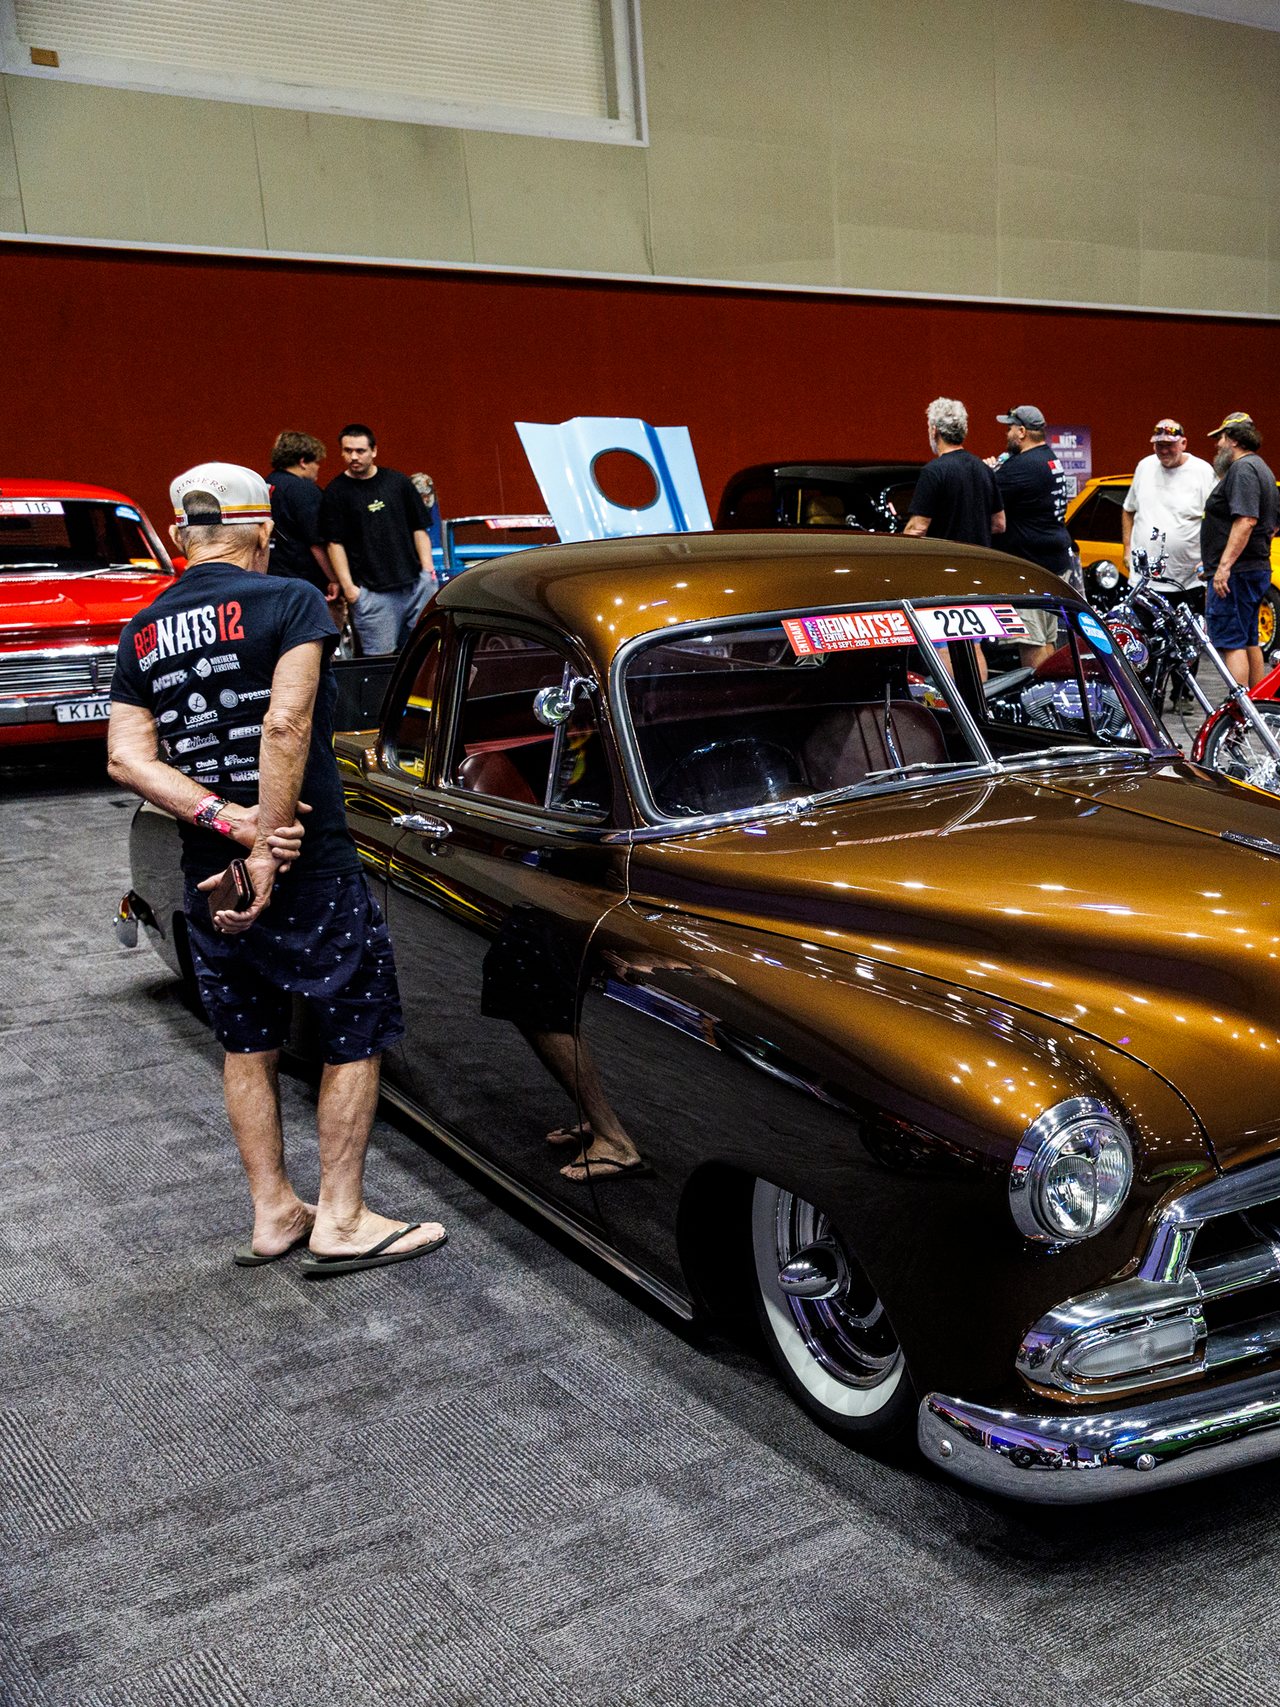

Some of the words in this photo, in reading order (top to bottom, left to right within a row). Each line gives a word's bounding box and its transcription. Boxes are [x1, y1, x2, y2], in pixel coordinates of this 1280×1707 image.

[25, 502, 51, 514] 116
[817, 617, 845, 635] RED
[933, 608, 986, 637] 229
[133, 622, 157, 660] RED
[787, 621, 811, 653] ENTRANT
[873, 637, 890, 645] ALICE
[891, 635, 915, 644] SPRINGS
[138, 648, 160, 672] CENTRE
[210, 653, 239, 665] NORTHERN
[211, 661, 241, 674] TERRITORY
[183, 709, 218, 725] Lasseters
[195, 758, 218, 769] Chubb
